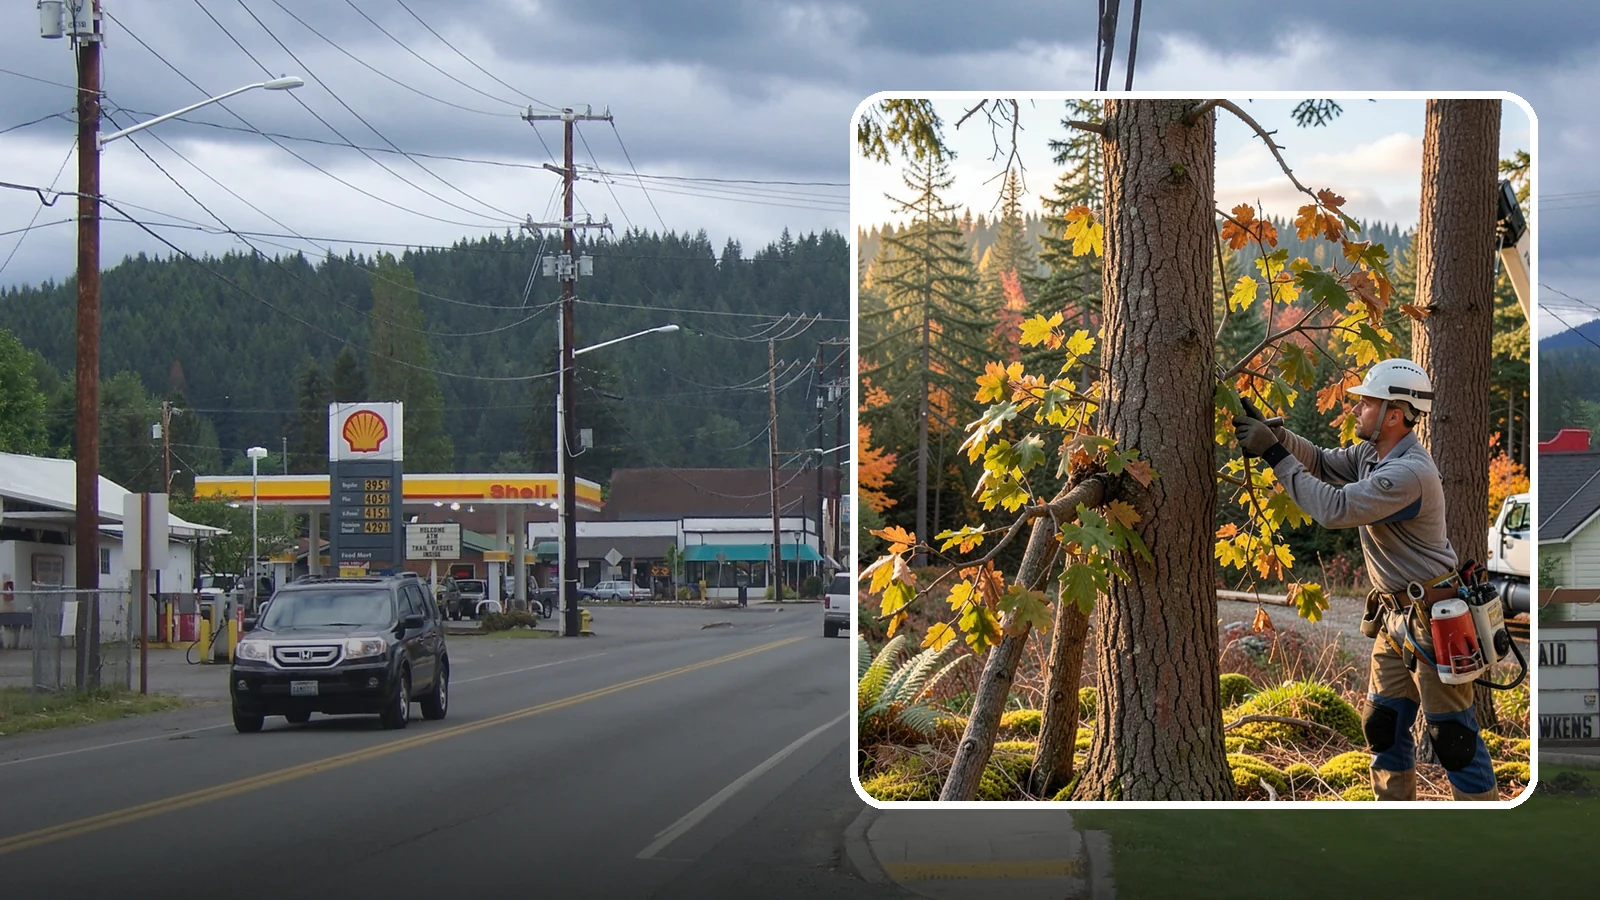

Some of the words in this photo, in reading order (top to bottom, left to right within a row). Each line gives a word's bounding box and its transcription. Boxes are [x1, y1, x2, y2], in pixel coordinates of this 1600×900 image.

[366, 480, 384, 490] 395
[490, 484, 547, 499] Shell
[365, 494, 384, 504] 405
[365, 508, 384, 518] 415
[366, 522, 384, 532] 429
[1538, 642, 1567, 665] AID
